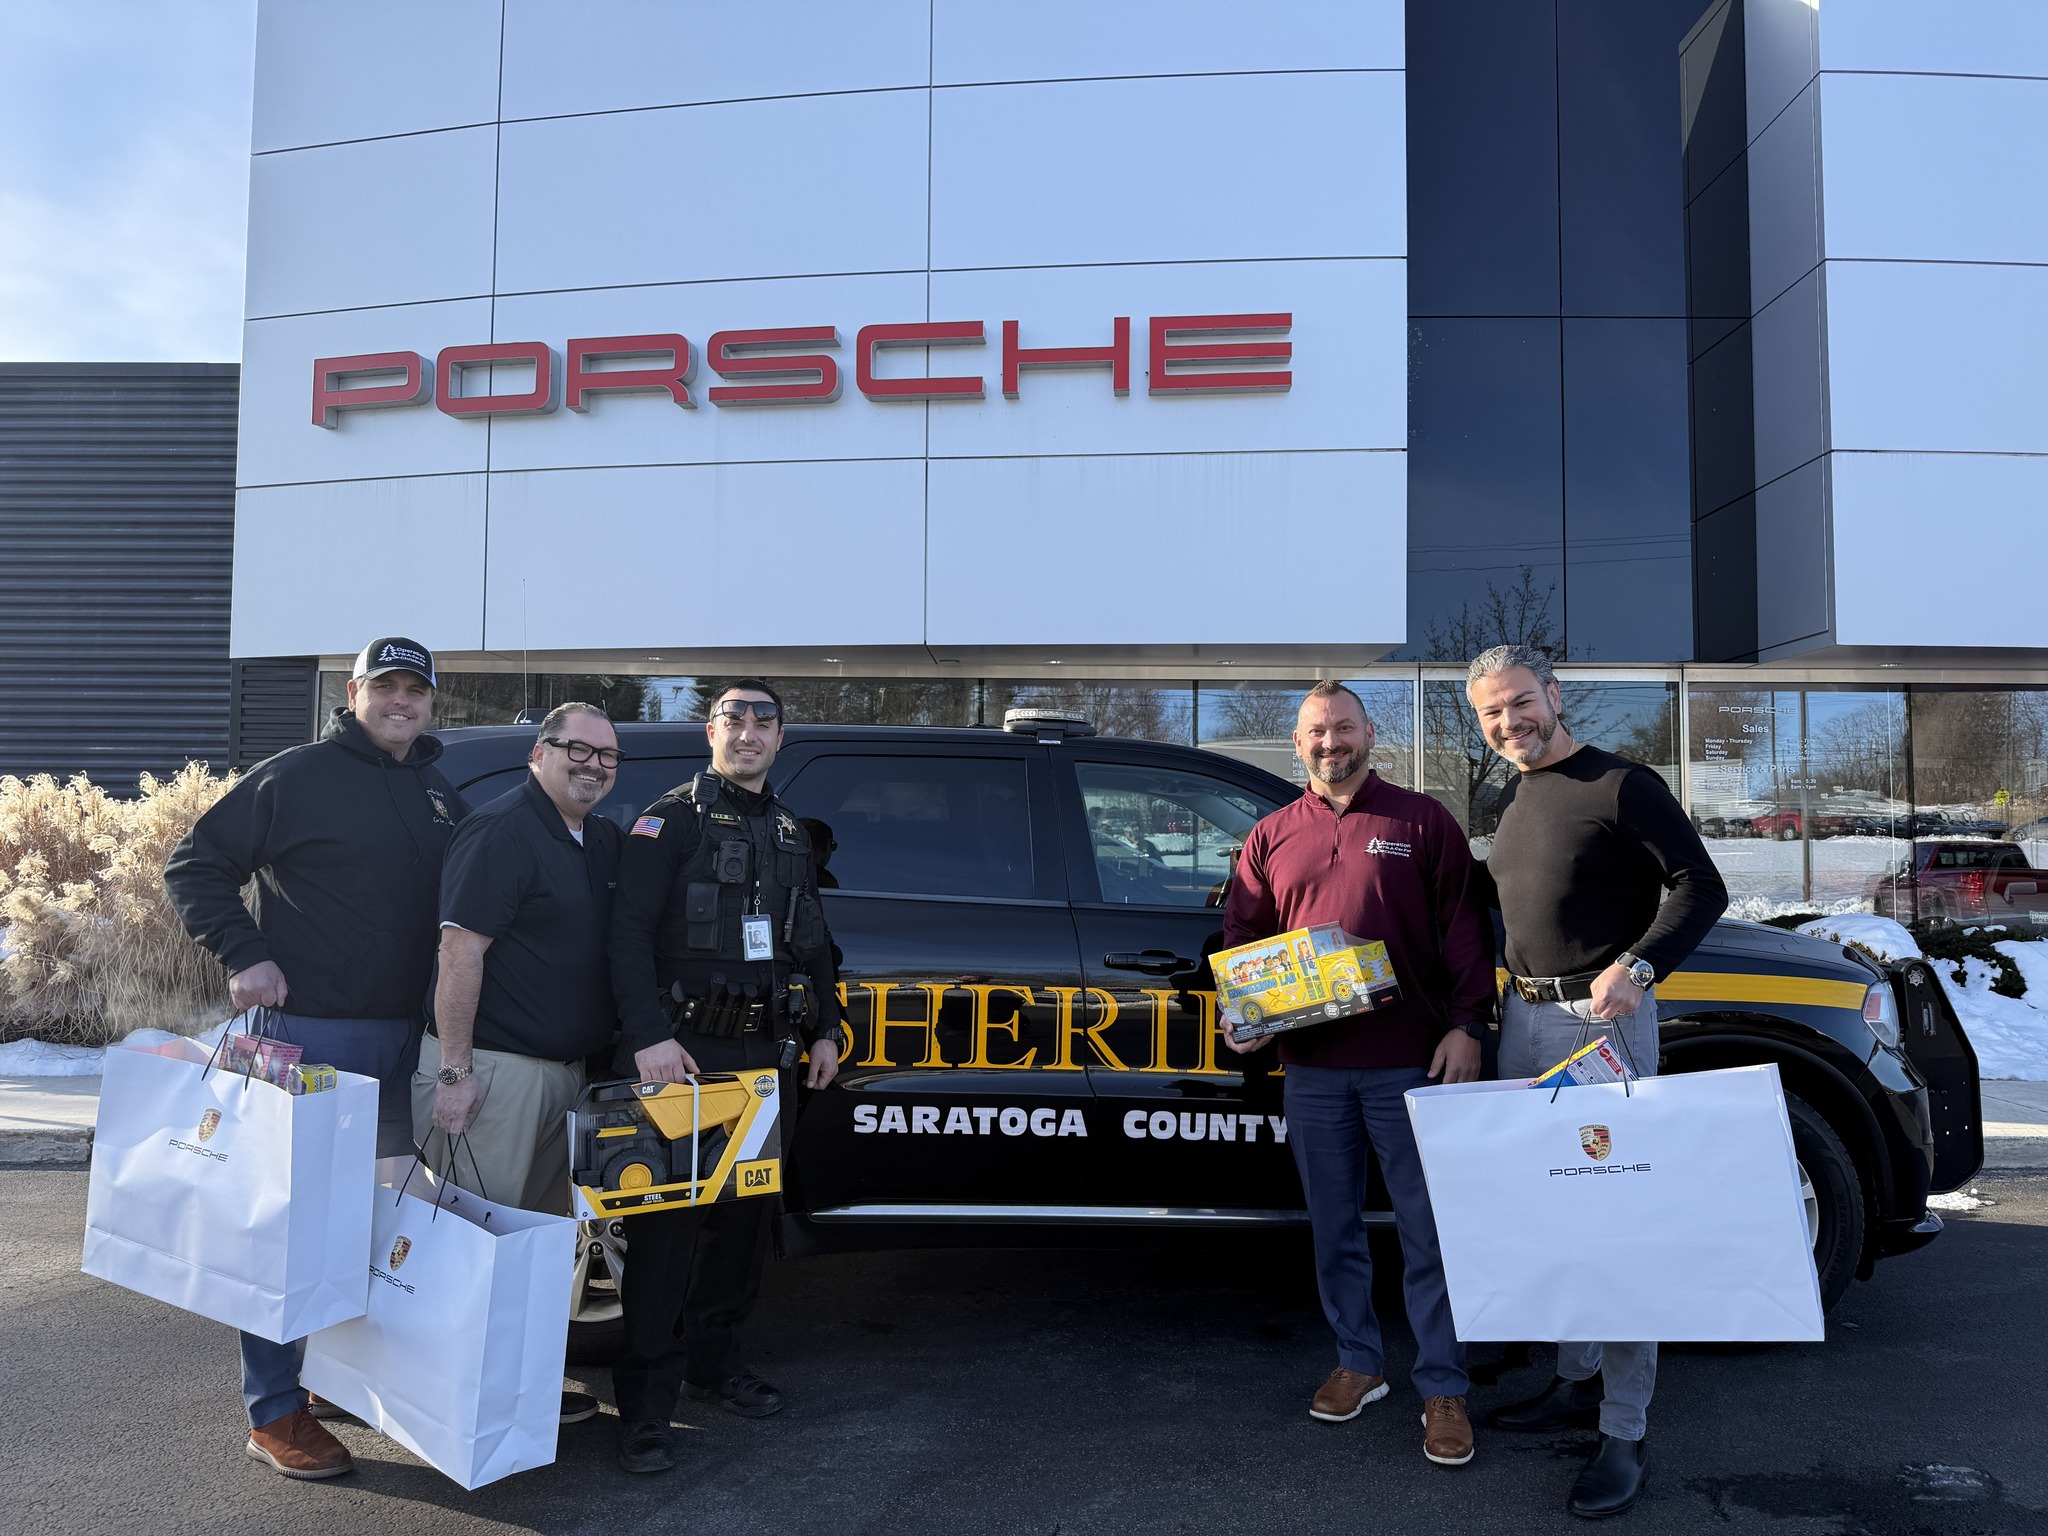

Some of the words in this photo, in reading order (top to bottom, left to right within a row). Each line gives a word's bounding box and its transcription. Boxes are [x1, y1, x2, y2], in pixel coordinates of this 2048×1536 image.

[312, 312, 1293, 430] PORSCHE
[396, 647, 426, 659] Operation
[1742, 724, 1769, 733] Sales
[1720, 764, 1756, 773] Service
[1759, 764, 1766, 773] &
[1770, 764, 1796, 773] Parts
[1381, 840, 1411, 848] Operation
[1227, 977, 1278, 999] ENGINEERING
[1278, 971, 1297, 987] LAB
[642, 1085, 655, 1094] CAT
[853, 1104, 1088, 1138] SARATOGA
[1122, 1109, 1288, 1144] COUNTY
[168, 1138, 229, 1163] PORSCHE
[1549, 1163, 1652, 1177] PORSCHE
[744, 1167, 772, 1188] CAT
[643, 1193, 663, 1201] STEEL
